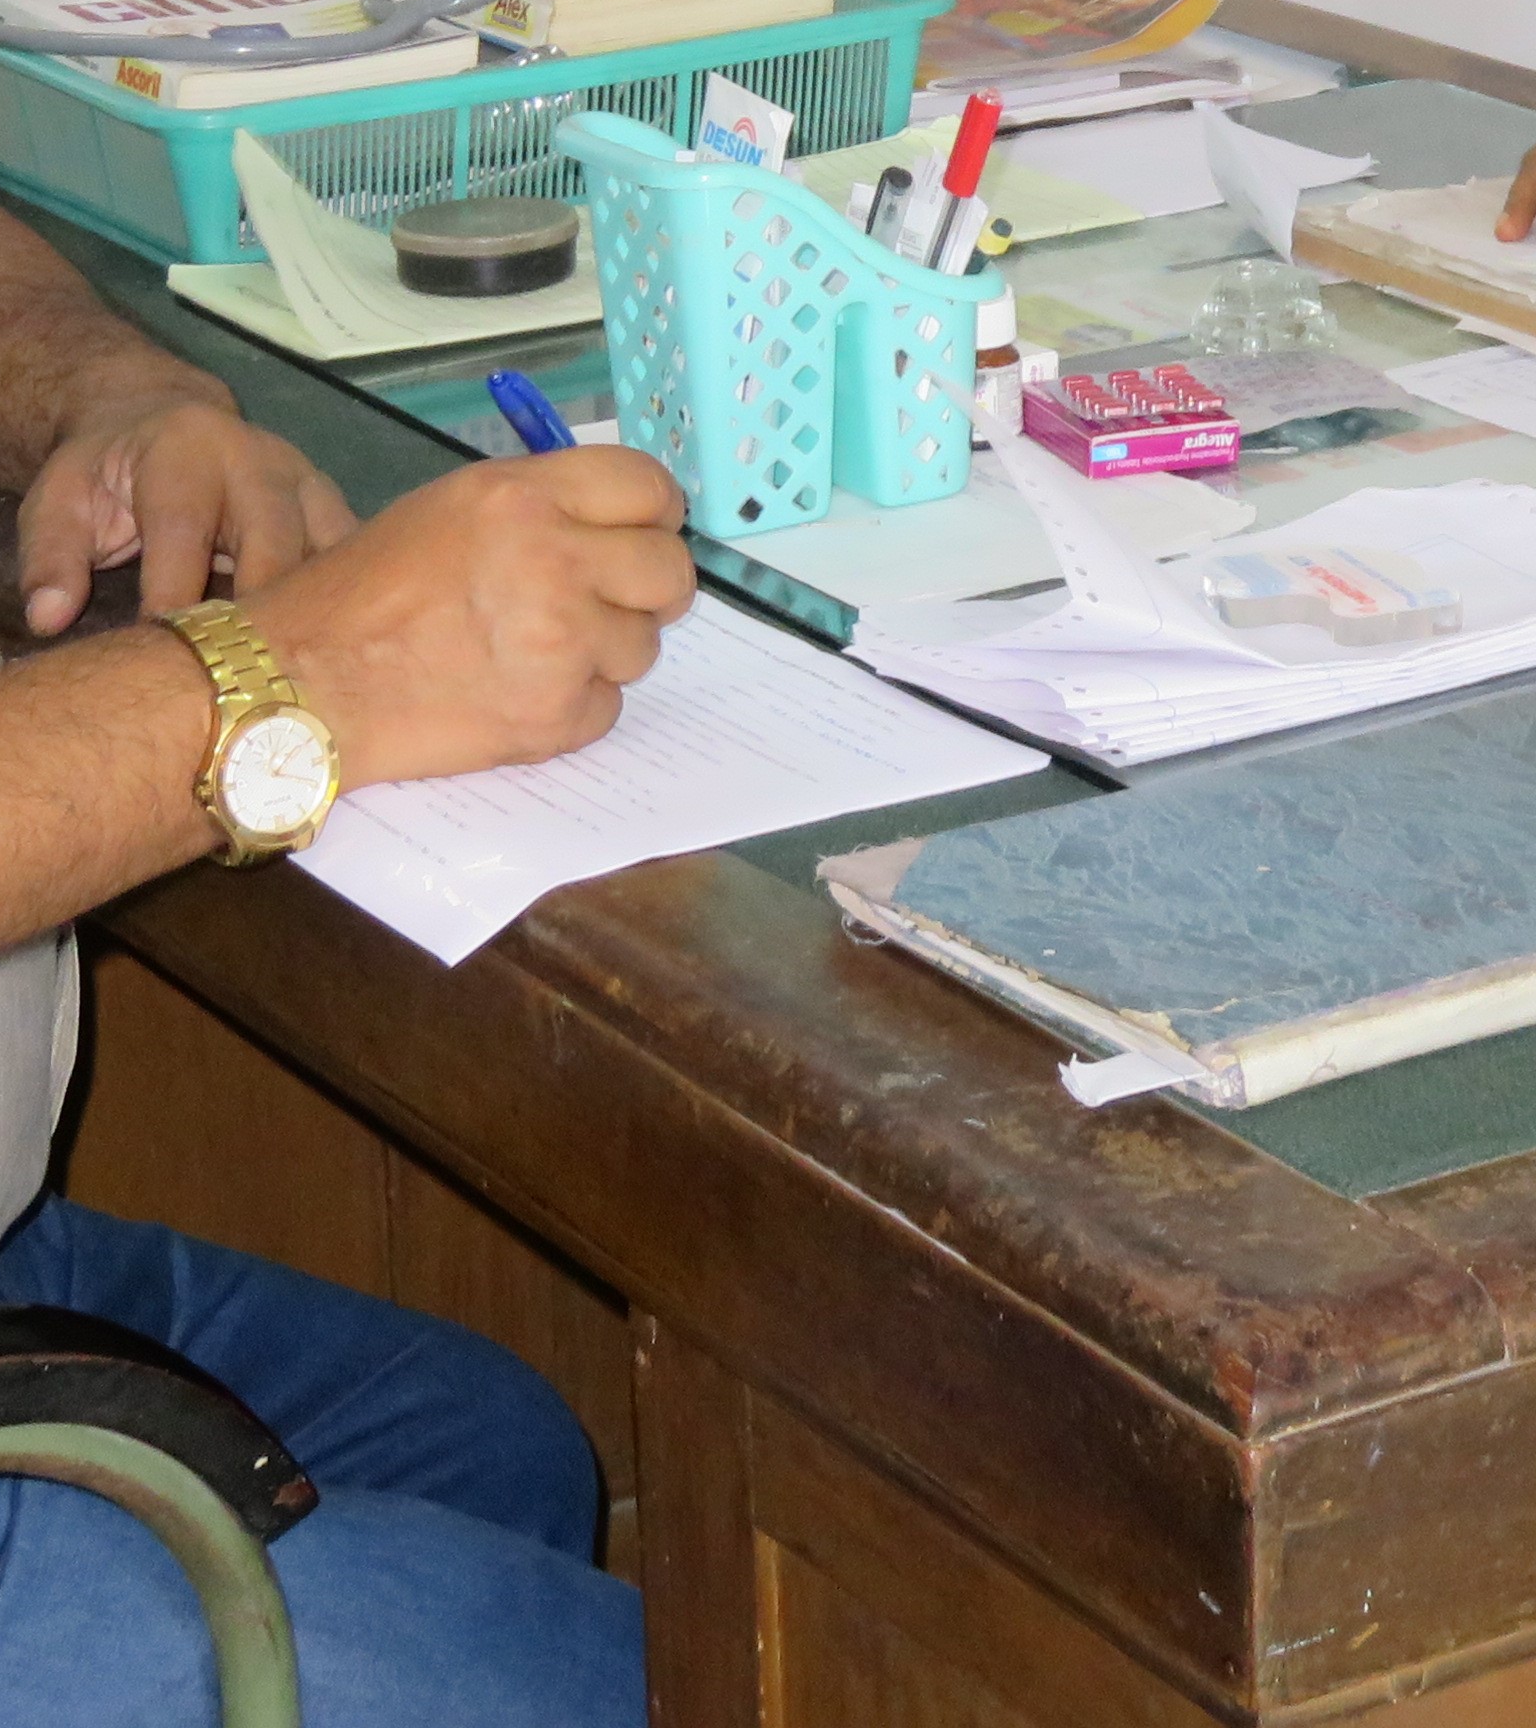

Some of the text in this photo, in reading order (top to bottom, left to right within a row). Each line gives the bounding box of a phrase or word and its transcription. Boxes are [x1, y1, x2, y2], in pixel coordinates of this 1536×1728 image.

[116, 57, 162, 99] Ascoril
[703, 119, 764, 166] DESUN
[1183, 432, 1236, 450] Allegra
